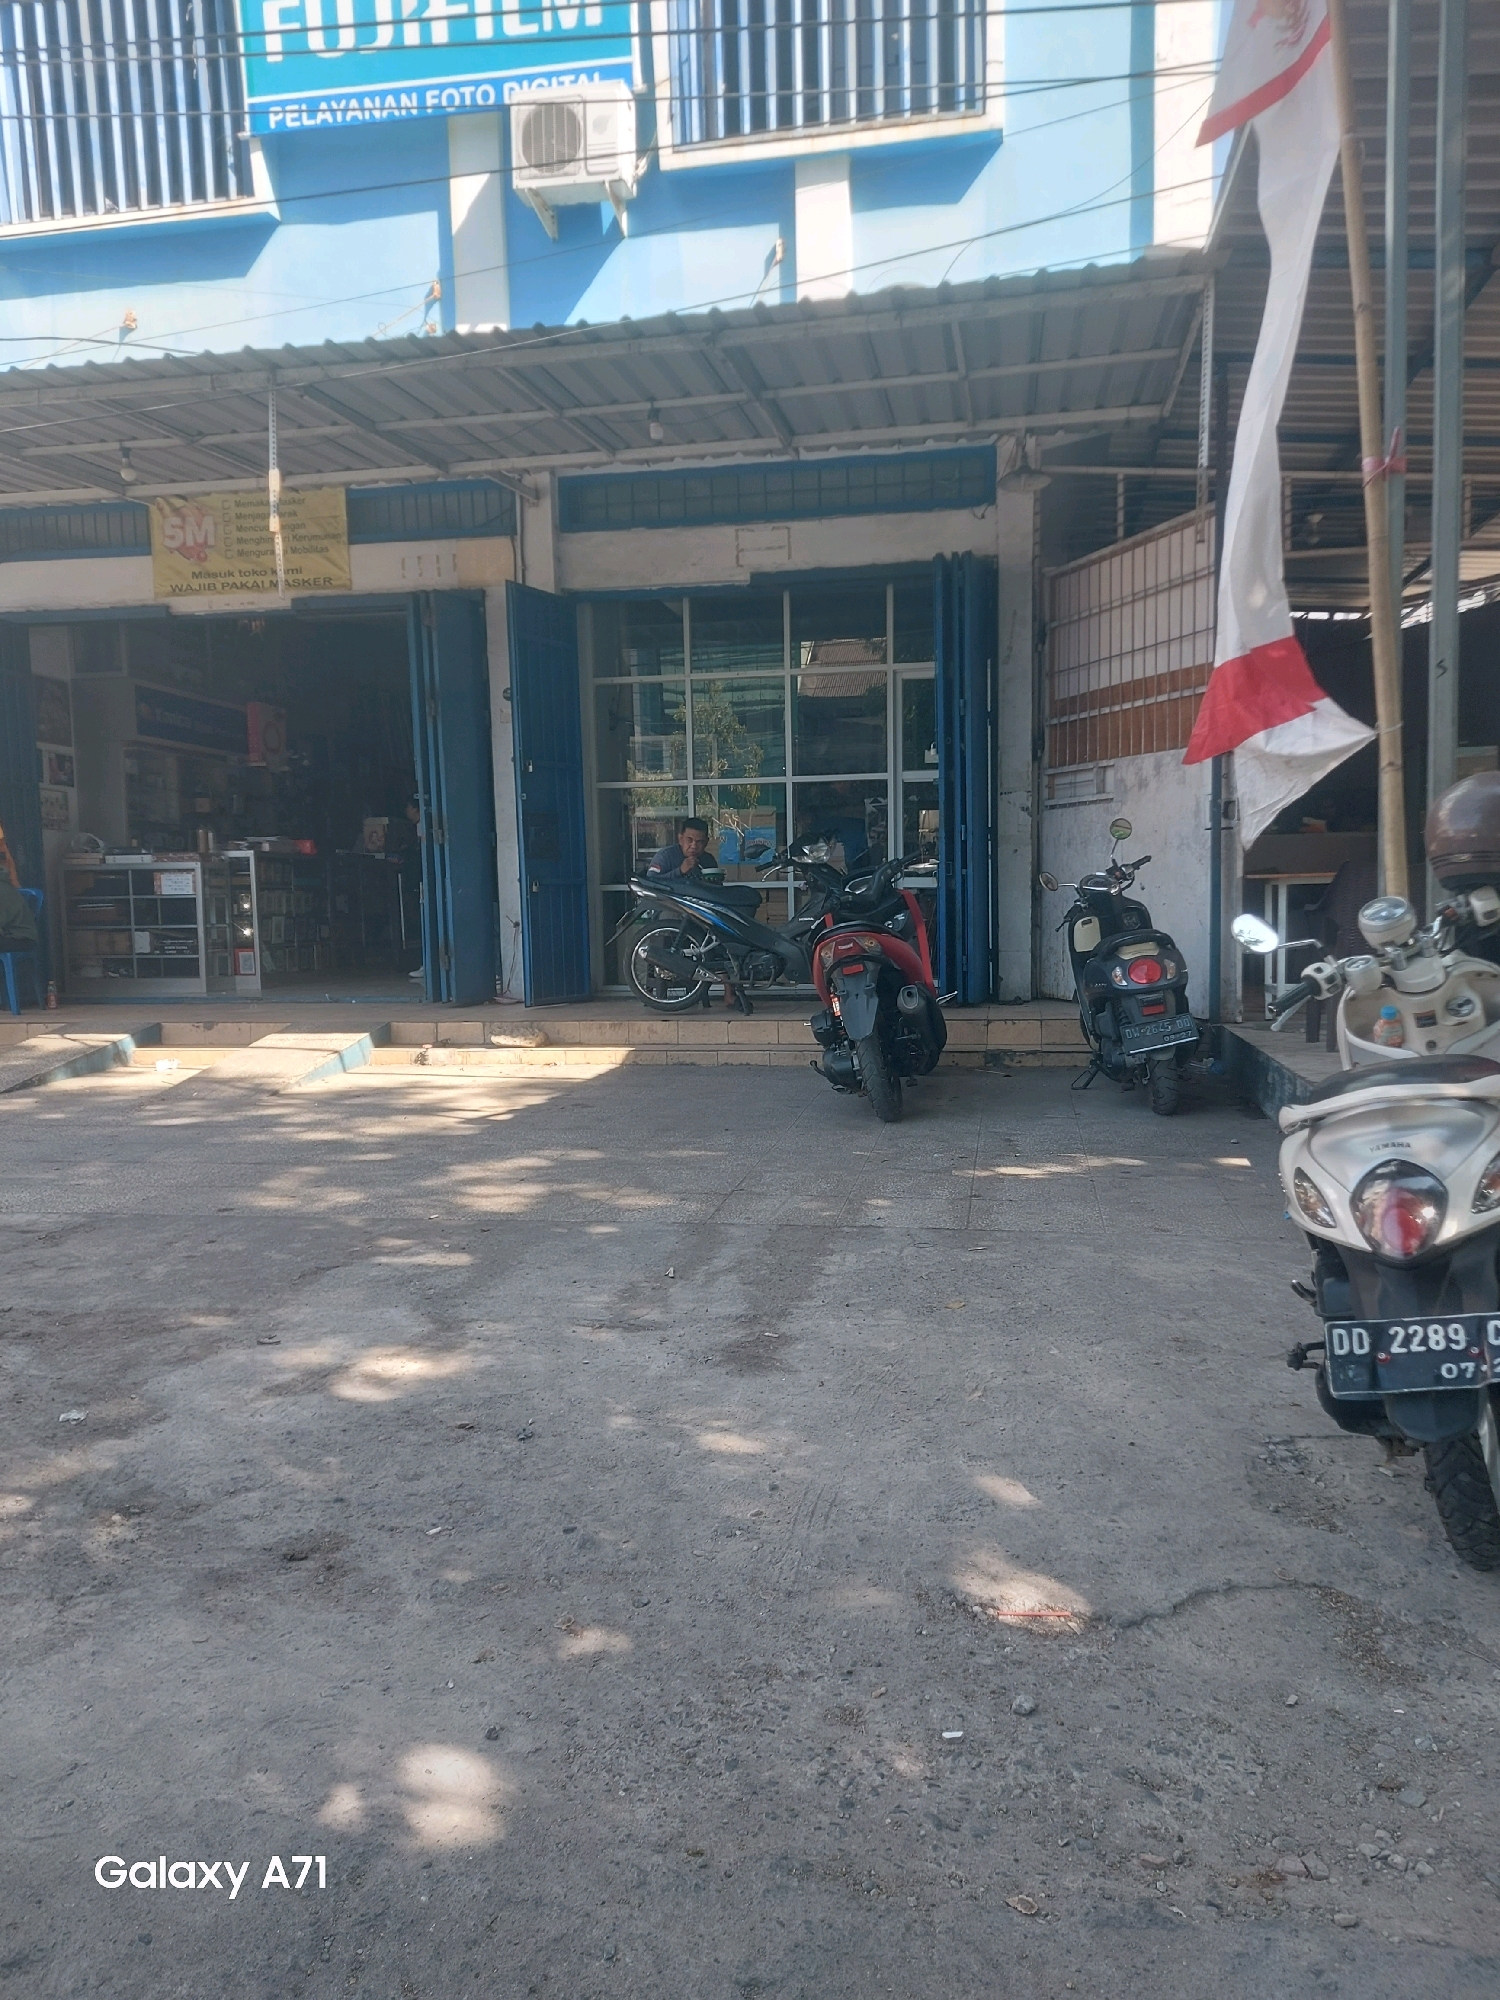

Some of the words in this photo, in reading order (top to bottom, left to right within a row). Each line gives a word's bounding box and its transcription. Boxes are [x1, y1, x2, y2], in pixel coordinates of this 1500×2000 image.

[268, 94, 418, 130] PELAYANAN
[425, 83, 496, 113] FOTO
[234, 498, 270, 508] Memaka
[278, 497, 306, 506] asker
[280, 522, 306, 532] angan
[290, 545, 329, 555] Mobilitas
[191, 570, 235, 580] Masuk
[238, 568, 267, 578] toko
[271, 566, 303, 576] kmi
[170, 582, 217, 593] WAJIB
[221, 579, 265, 591] PAKAI
[1369, 1141, 1411, 1153] YAMAHA
[1332, 1328, 1370, 1356] DD
[1388, 1323, 1467, 1354] 2289
